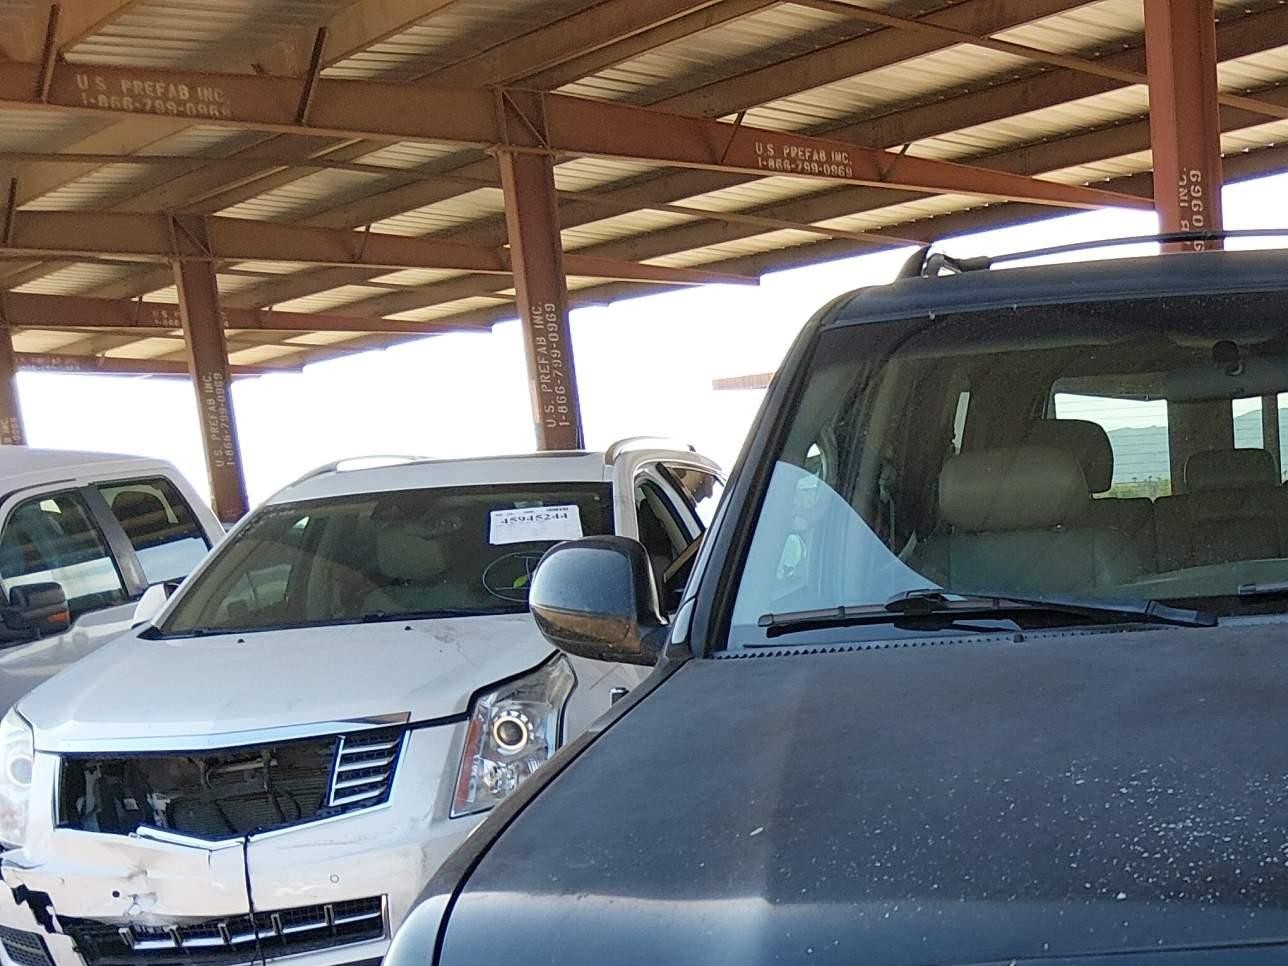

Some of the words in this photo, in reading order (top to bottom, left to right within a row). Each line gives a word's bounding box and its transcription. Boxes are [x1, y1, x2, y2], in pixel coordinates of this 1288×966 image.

[121, 80, 189, 99] PREFAB
[783, 145, 826, 162] PREFAB
[831, 151, 853, 165] INC.
[532, 302, 545, 329] INC.
[535, 337, 553, 392] PREFAB
[544, 303, 570, 426] 1-866-799-0969
[206, 398, 221, 441] PREFAB
[544, 400, 557, 427] U.S.
